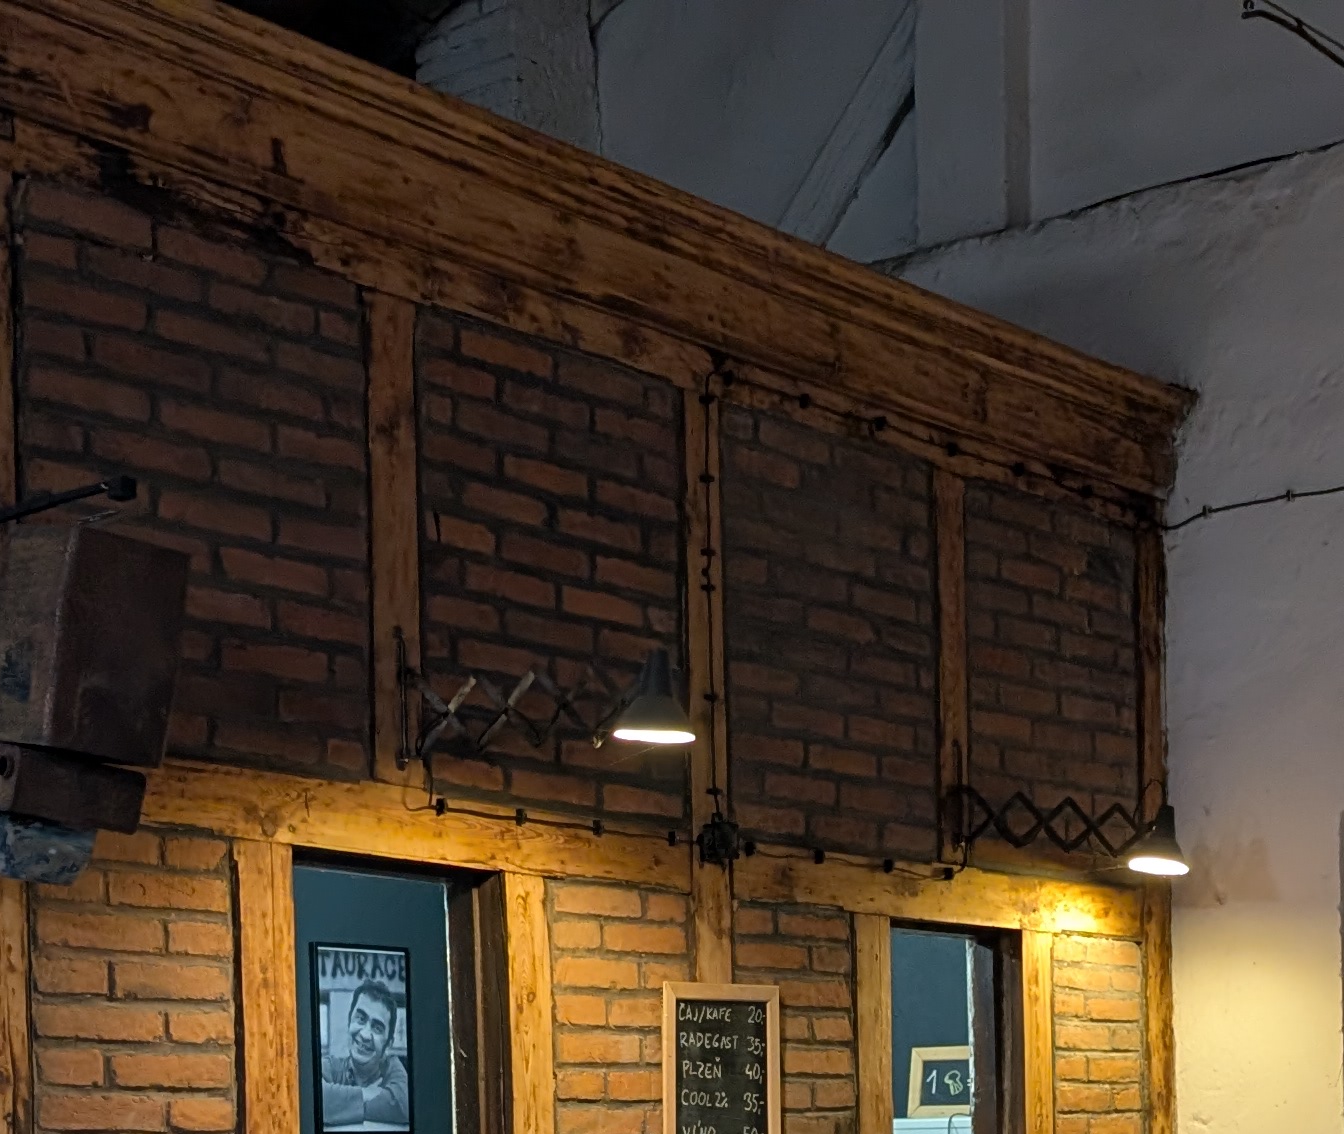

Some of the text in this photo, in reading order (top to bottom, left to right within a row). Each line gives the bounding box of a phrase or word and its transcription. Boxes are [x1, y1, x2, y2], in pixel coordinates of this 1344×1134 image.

[678, 1002, 732, 1024] ČAJ/KAFE
[680, 1031, 738, 1050] RADEGAST
[681, 1089, 712, 1107] COOL
